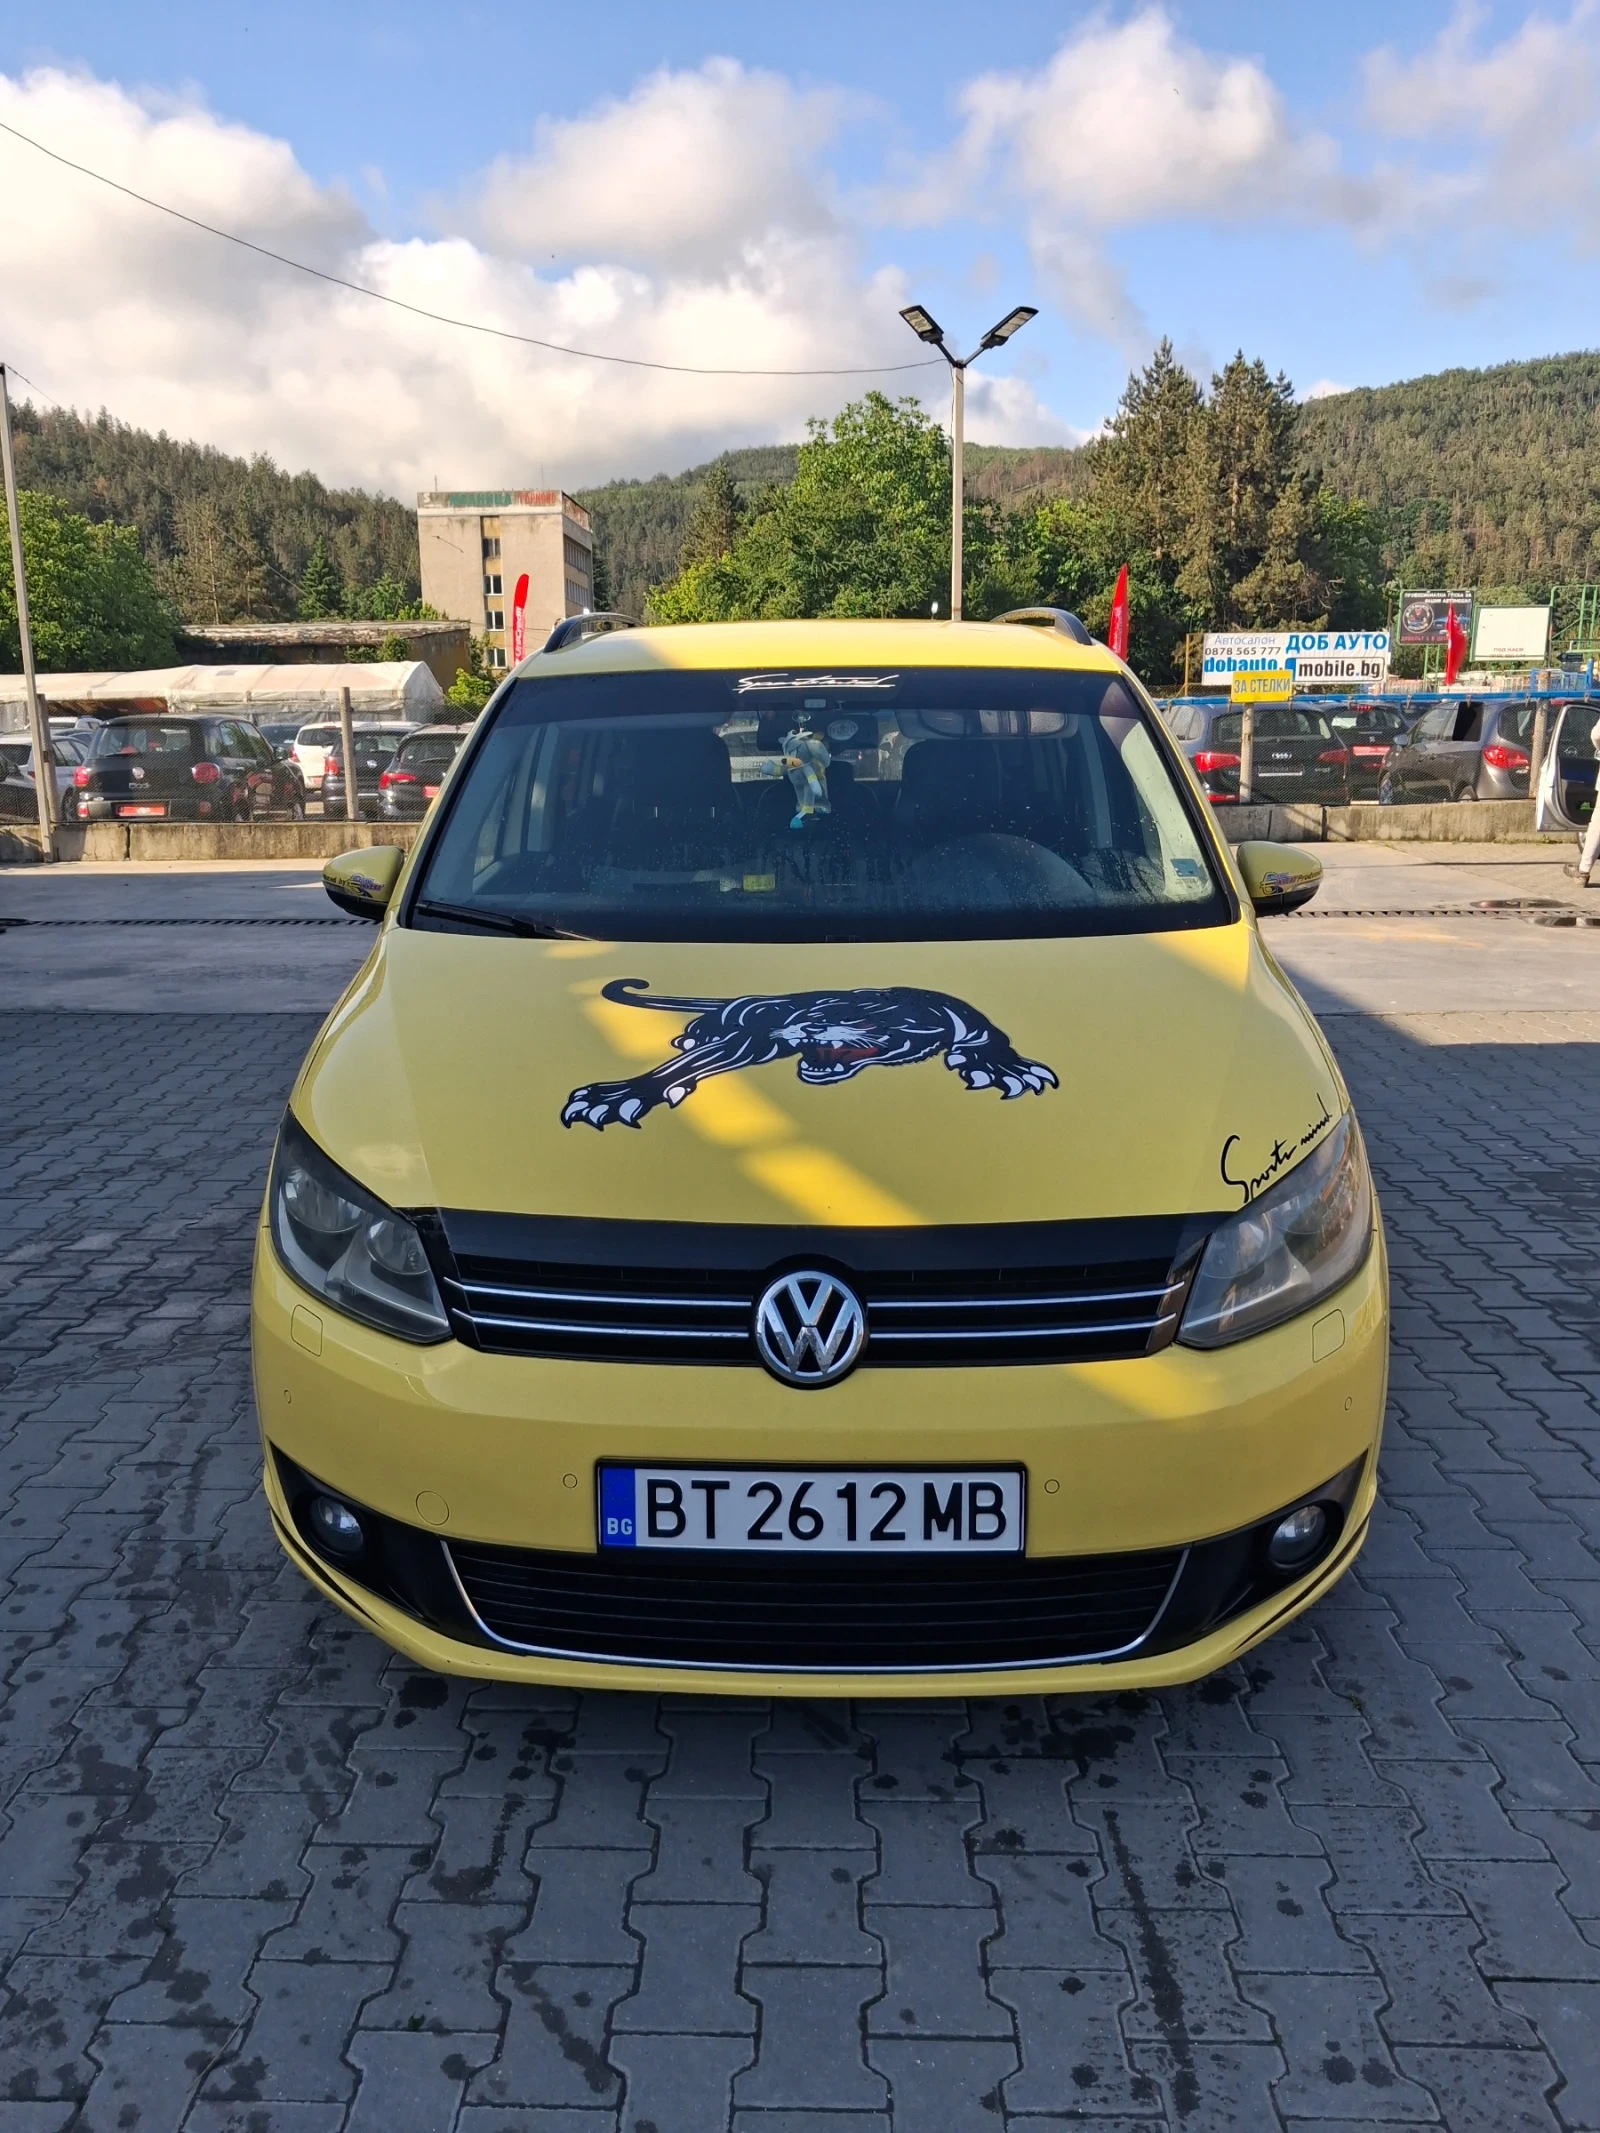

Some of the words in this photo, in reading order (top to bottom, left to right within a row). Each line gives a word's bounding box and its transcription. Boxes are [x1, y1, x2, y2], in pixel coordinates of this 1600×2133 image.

[1204, 647, 1233, 656] 0878
[1236, 647, 1257, 655] 565
[1260, 646, 1282, 655] 777
[1214, 635, 1276, 646] Автосалон
[1285, 634, 1329, 654] ДОБ
[1334, 634, 1388, 651] АУТО
[1298, 660, 1381, 678] mobile.bg
[1233, 680, 1247, 693] ЗА
[1250, 679, 1291, 693] СТЕЛКИ
[646, 1478, 730, 1540] BT
[747, 1480, 907, 1542] 2612
[922, 1481, 1007, 1541] MB
[606, 1516, 633, 1536] BG
